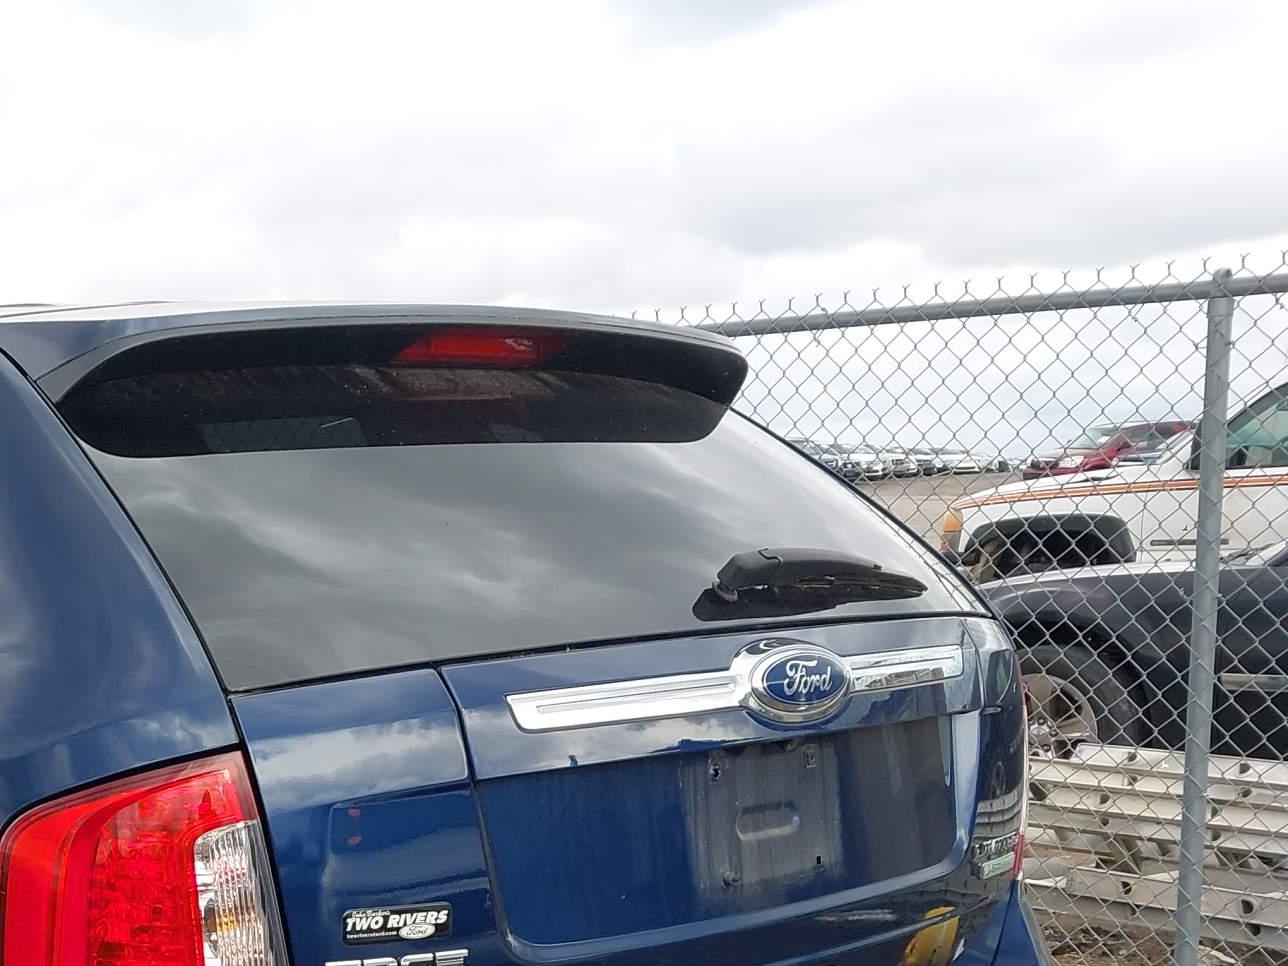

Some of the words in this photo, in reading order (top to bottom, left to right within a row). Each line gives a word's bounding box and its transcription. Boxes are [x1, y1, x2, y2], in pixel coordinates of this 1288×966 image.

[783, 660, 832, 696] Ford
[346, 915, 384, 932] TWO
[386, 909, 449, 929] RIVERS
[405, 927, 428, 937] Ford
